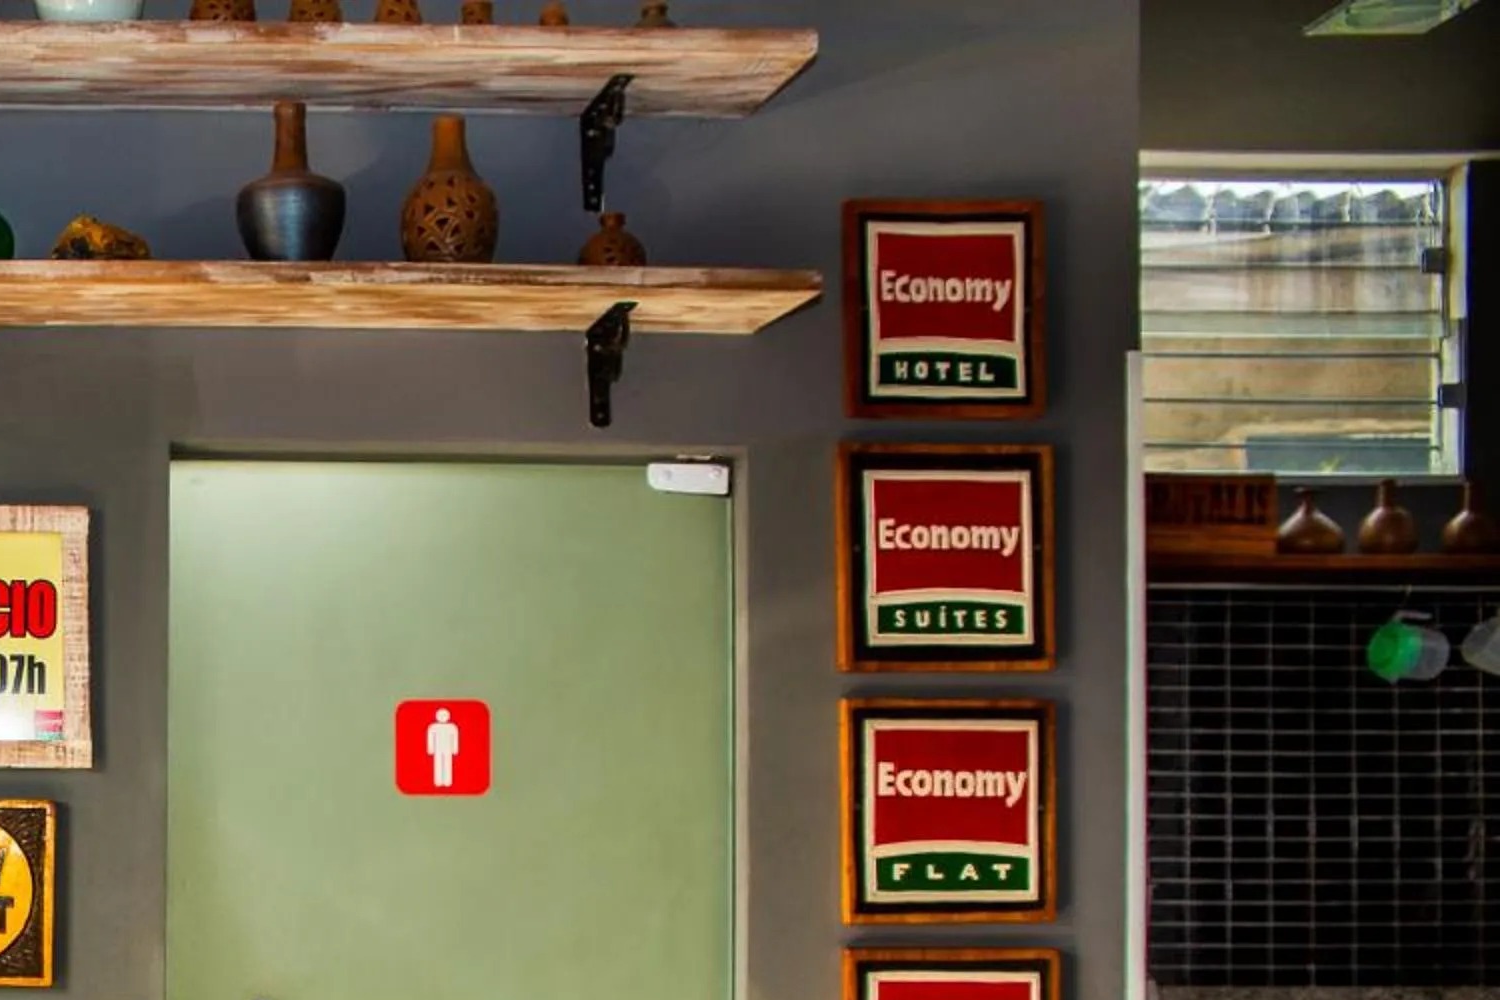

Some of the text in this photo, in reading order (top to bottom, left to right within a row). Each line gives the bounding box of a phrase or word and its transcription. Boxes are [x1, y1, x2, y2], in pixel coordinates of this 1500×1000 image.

[880, 269, 1012, 312] Economy
[895, 360, 995, 382] HOTEL
[878, 518, 1019, 557] Economy
[877, 761, 1027, 808] Economy
[892, 864, 1012, 880] FLAT
